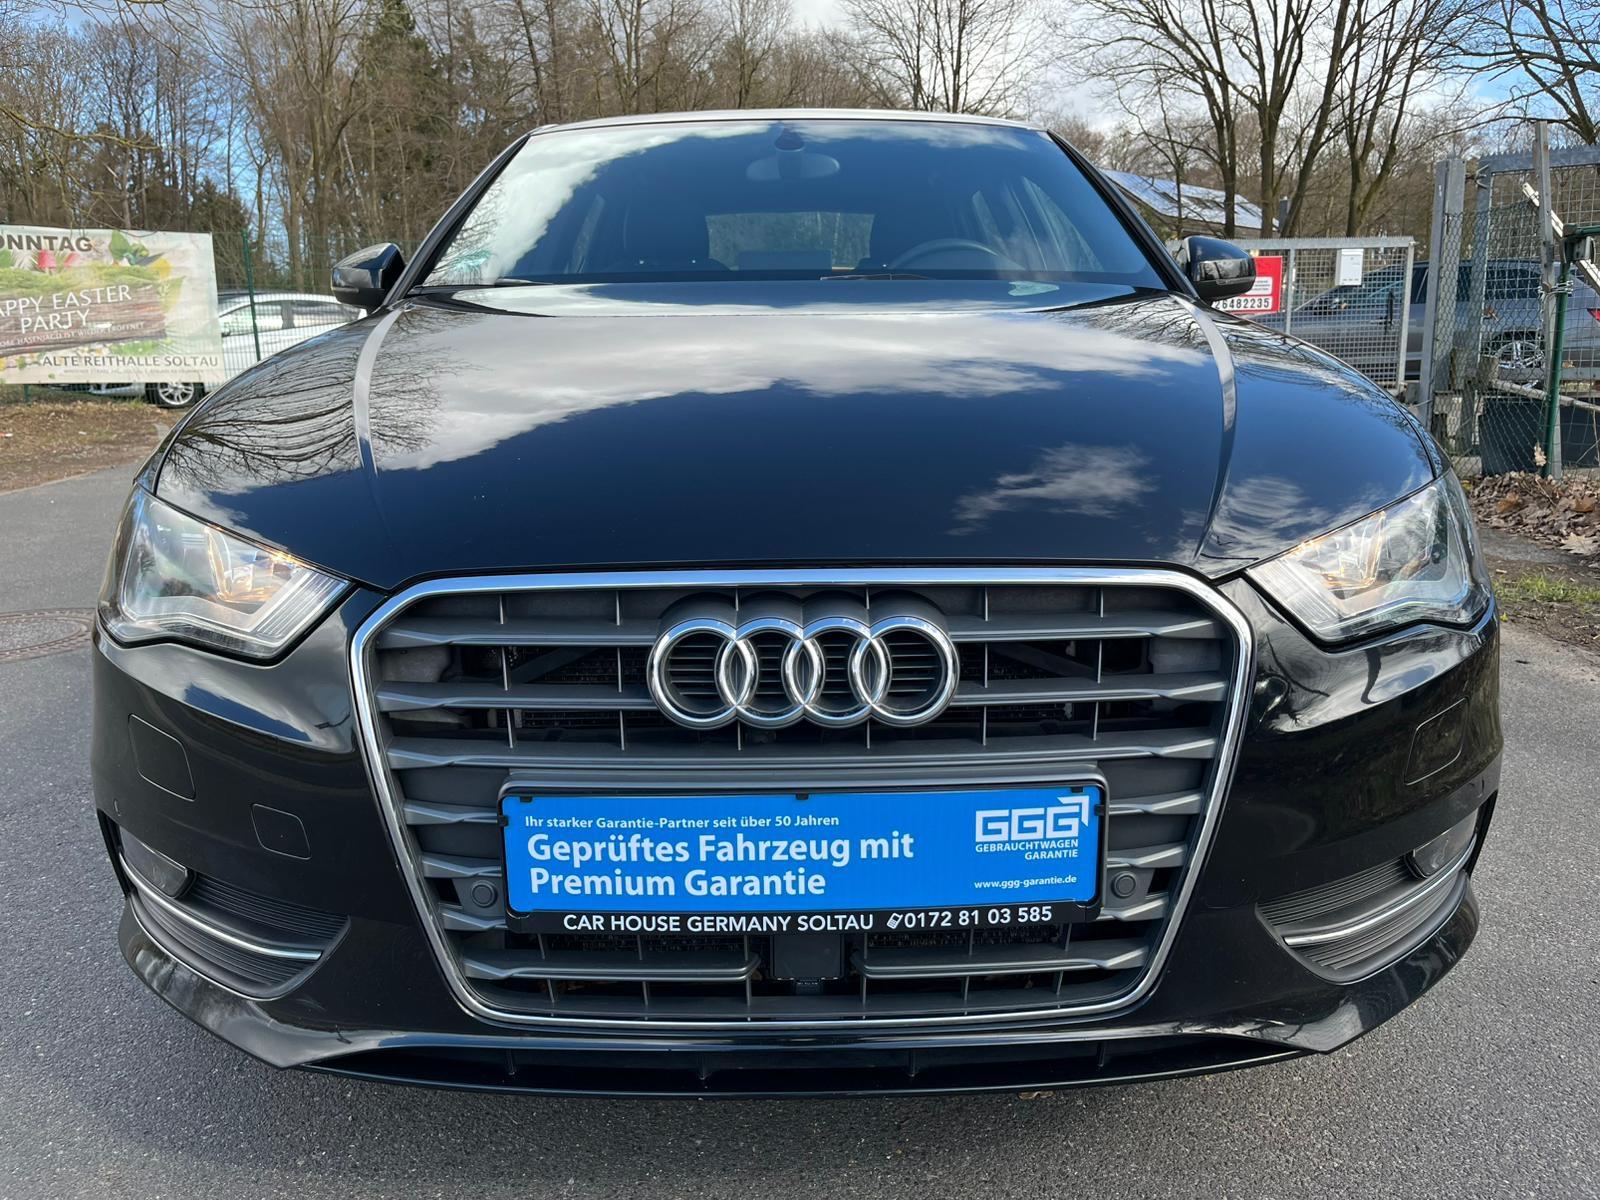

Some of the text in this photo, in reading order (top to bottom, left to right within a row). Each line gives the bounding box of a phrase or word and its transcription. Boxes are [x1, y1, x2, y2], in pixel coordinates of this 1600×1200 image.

[53, 285, 132, 310] EASTER
[21, 309, 90, 334] PARTY
[43, 356, 218, 367] ALTE REITHALLE SOLTAU
[525, 814, 840, 829] Ihr starker Garantie-Partner seit über 50 Jahren
[975, 805, 1080, 842] GGG
[527, 830, 914, 868] Geprüftes Fahrzeug mit
[975, 839, 1079, 853] GEBRAUCHTWAGEN
[1024, 849, 1078, 861] GARANTIE
[530, 868, 826, 896] Premium Garantie
[974, 875, 1077, 889] www.ggg-garantie.de
[563, 906, 1052, 932] CAR HOUSE GERMANY SOLTAU 0172 81 03 585
